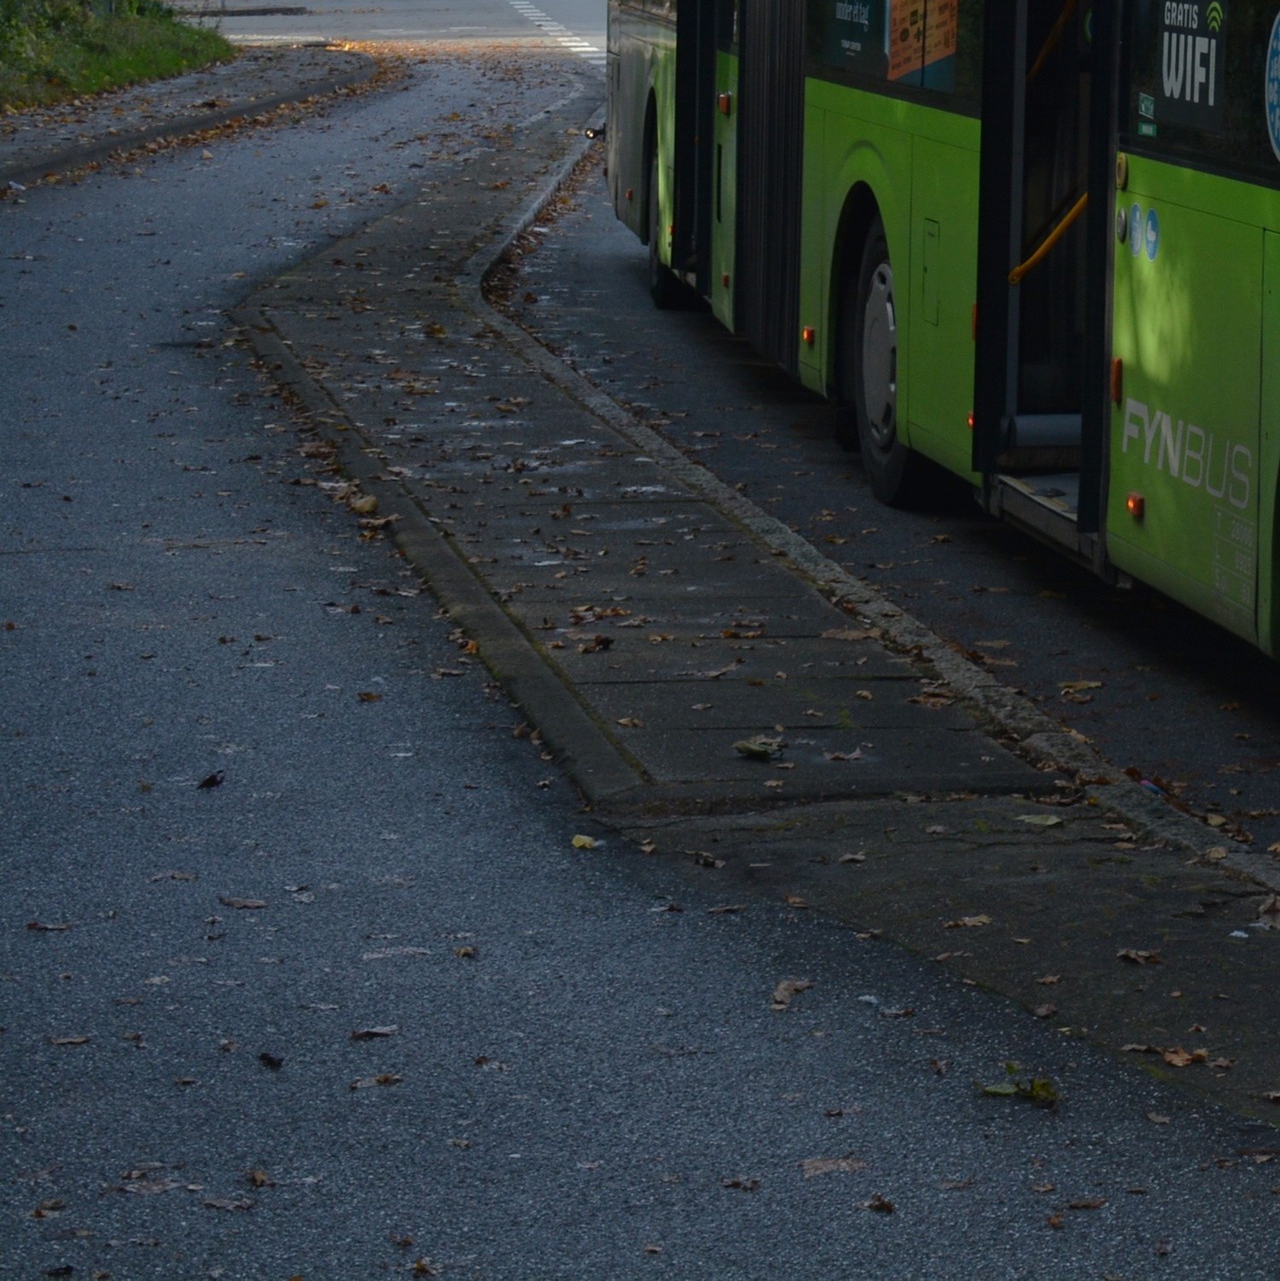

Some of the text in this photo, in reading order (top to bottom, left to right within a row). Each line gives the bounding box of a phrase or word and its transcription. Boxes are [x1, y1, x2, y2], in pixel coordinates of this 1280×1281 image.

[1164, 0, 1199, 30] GRATIS
[1162, 31, 1217, 107] WIFI
[1122, 397, 1252, 510] FYNBUS
